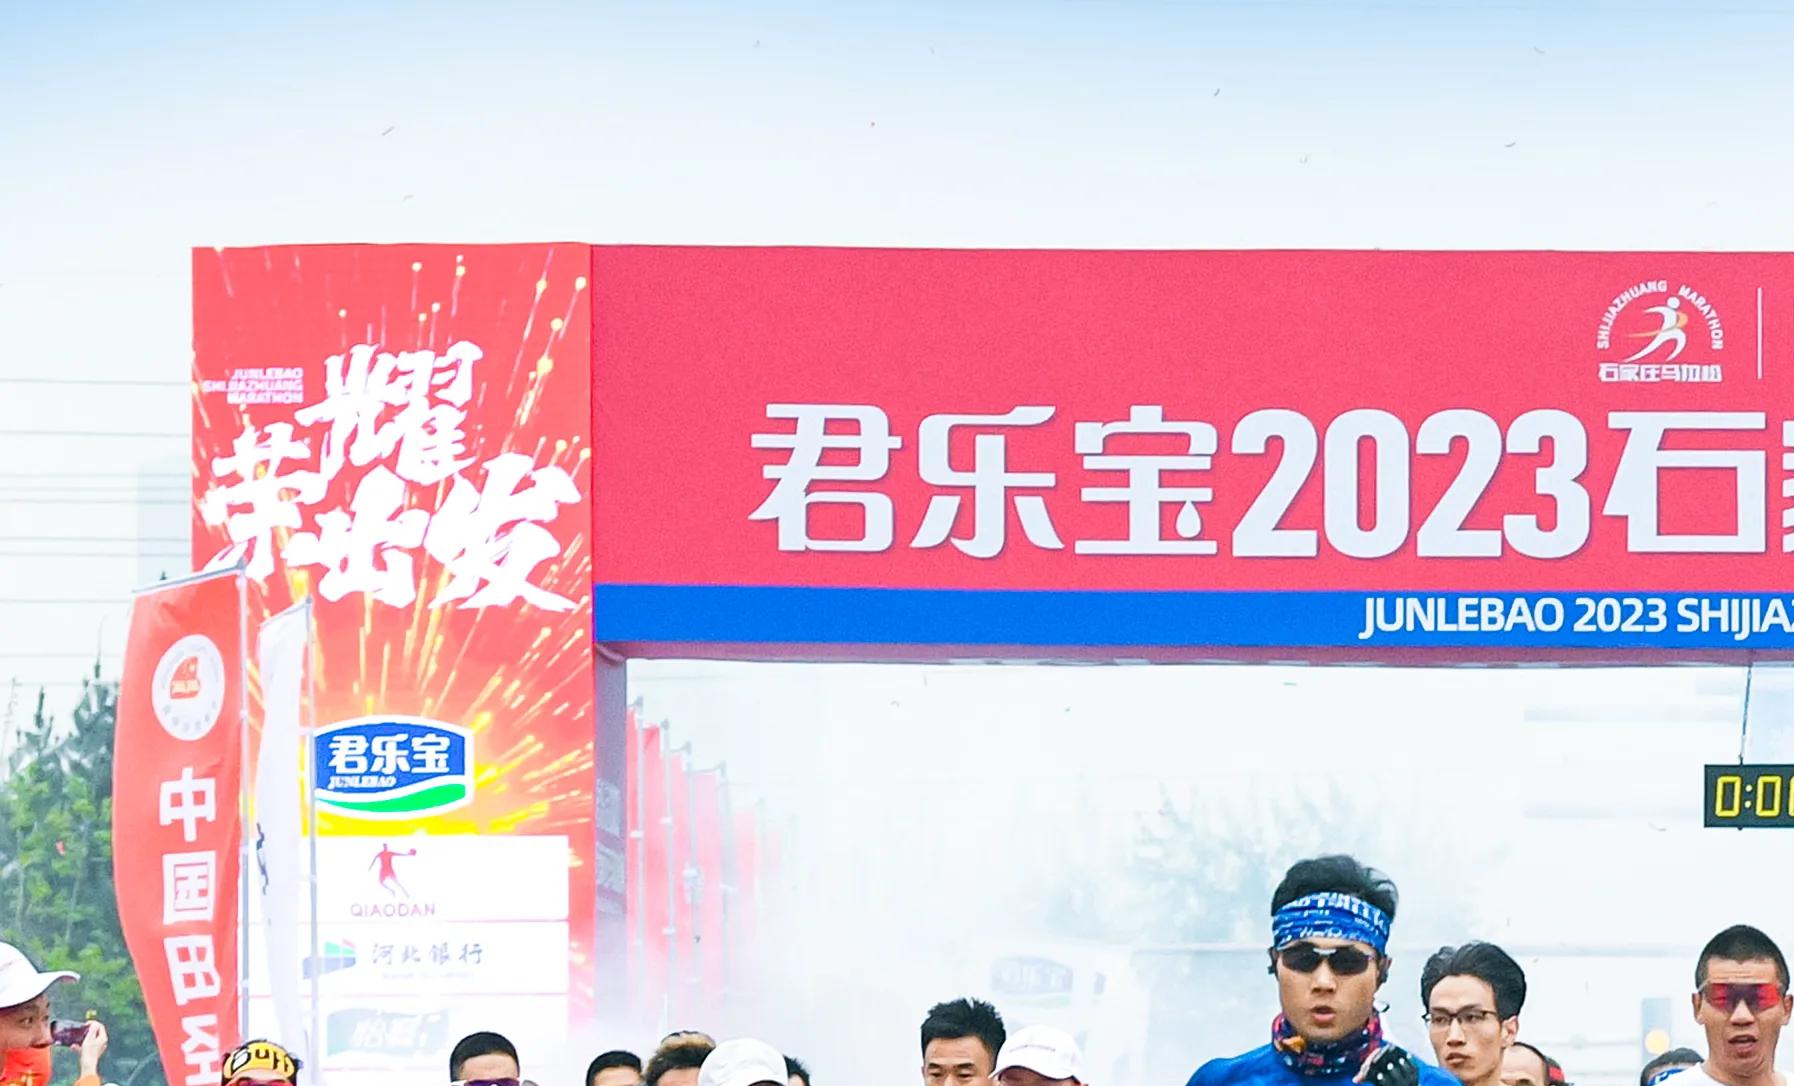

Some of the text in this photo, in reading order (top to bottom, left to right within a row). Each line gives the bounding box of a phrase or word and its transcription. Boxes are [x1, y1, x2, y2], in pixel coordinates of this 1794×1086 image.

[1597, 280, 1724, 350] SHIJIAZHUANG MARATHON
[1598, 364, 1723, 383] 石家庄马拉松
[1359, 597, 1560, 640] JUNLEBAO
[1574, 598, 1667, 633] 2023
[327, 734, 452, 776] 君乐宝
[326, 776, 398, 790] JUNLEBAO
[350, 902, 437, 917] QIAODAN
[370, 941, 484, 967] 河北银行
